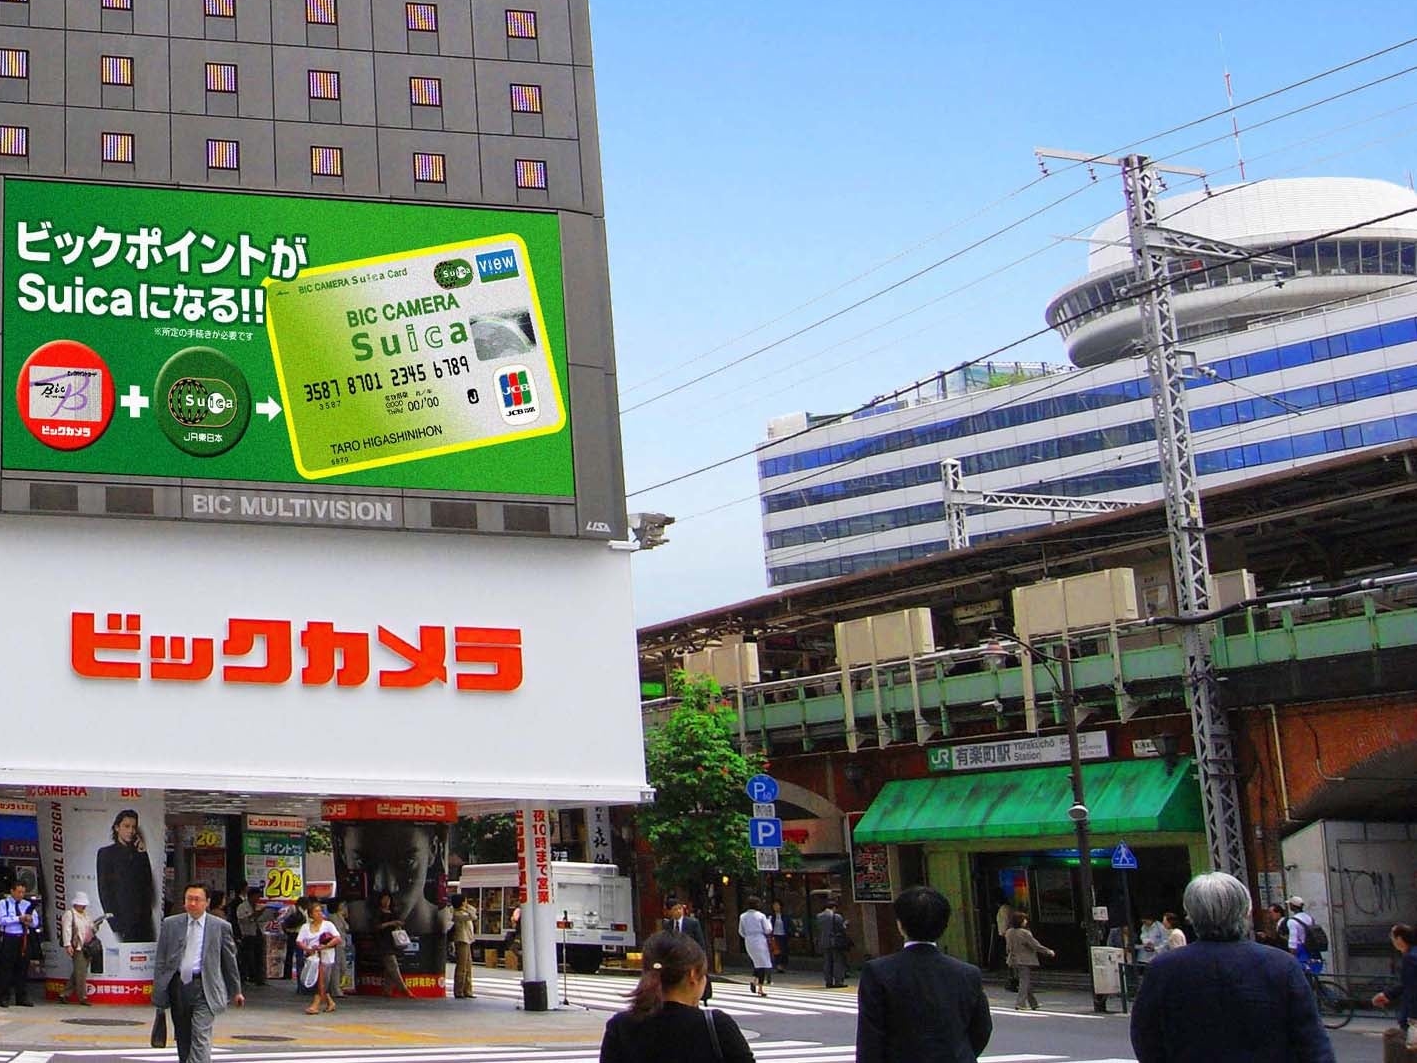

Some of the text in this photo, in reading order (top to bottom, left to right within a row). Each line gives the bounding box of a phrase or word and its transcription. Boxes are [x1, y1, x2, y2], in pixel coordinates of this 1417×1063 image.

[17, 221, 308, 279] ビックポイントが
[314, 278, 350, 291] CAMERA
[387, 268, 408, 279] Card
[442, 266, 471, 279] Suica
[346, 292, 461, 328] BIC CAMERA
[351, 320, 469, 362] Suica
[303, 355, 471, 403] 3587 8701 2345 6789
[503, 383, 530, 396] JCB
[185, 393, 234, 410] Suica
[41, 425, 91, 437] ビックカメラ
[183, 431, 223, 443] JR東日本
[329, 424, 443, 454] TARO HIGASHINIHON
[193, 494, 393, 522] BIC MULTIVISION
[70, 611, 523, 692] ビックカメラ
[931, 749, 949, 764] JR
[956, 743, 1011, 766] 有楽町駅
[1014, 751, 1041, 762] Station
[37, 786, 88, 797] CAMERA
[753, 782, 765, 800] P
[376, 803, 446, 817] ビックカメラ
[51, 801, 64, 853] DESIGN
[757, 821, 775, 844] P
[532, 809, 550, 905] 夜10時まで営業
[53, 858, 67, 911] GLOBAL
